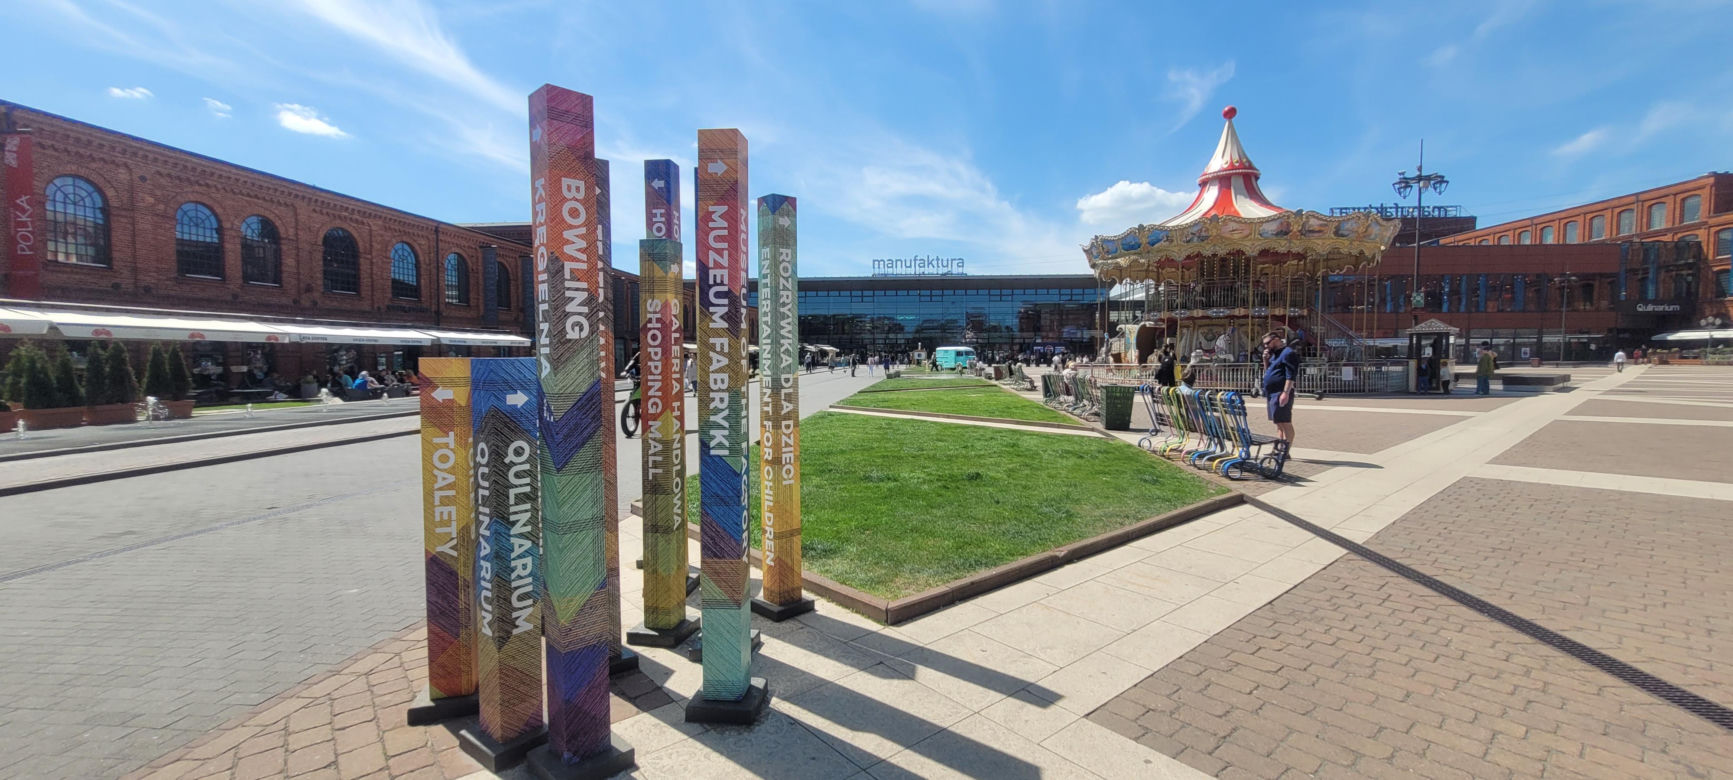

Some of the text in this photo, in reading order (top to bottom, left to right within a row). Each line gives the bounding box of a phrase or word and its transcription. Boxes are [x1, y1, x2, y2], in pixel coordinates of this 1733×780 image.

[15, 194, 35, 255] POLKA
[561, 177, 590, 340] BOWLING
[872, 254, 965, 269] manufaktura
[646, 298, 664, 480] SHOPPING MALL
[670, 299, 682, 530] GALERIA HANDLOWA
[708, 205, 730, 456] MUZEUM FABRYKI
[740, 208, 749, 564] MUSEUM OF THE FACTORY
[761, 248, 775, 566] ENTERTAINMENT FOR CHILDREN
[779, 248, 794, 485] ROZRYWKA DLA DZIECI
[432, 431, 458, 557] TOALETY
[476, 441, 493, 637] QULINARIUM
[503, 440, 534, 635] QULINARIUM
